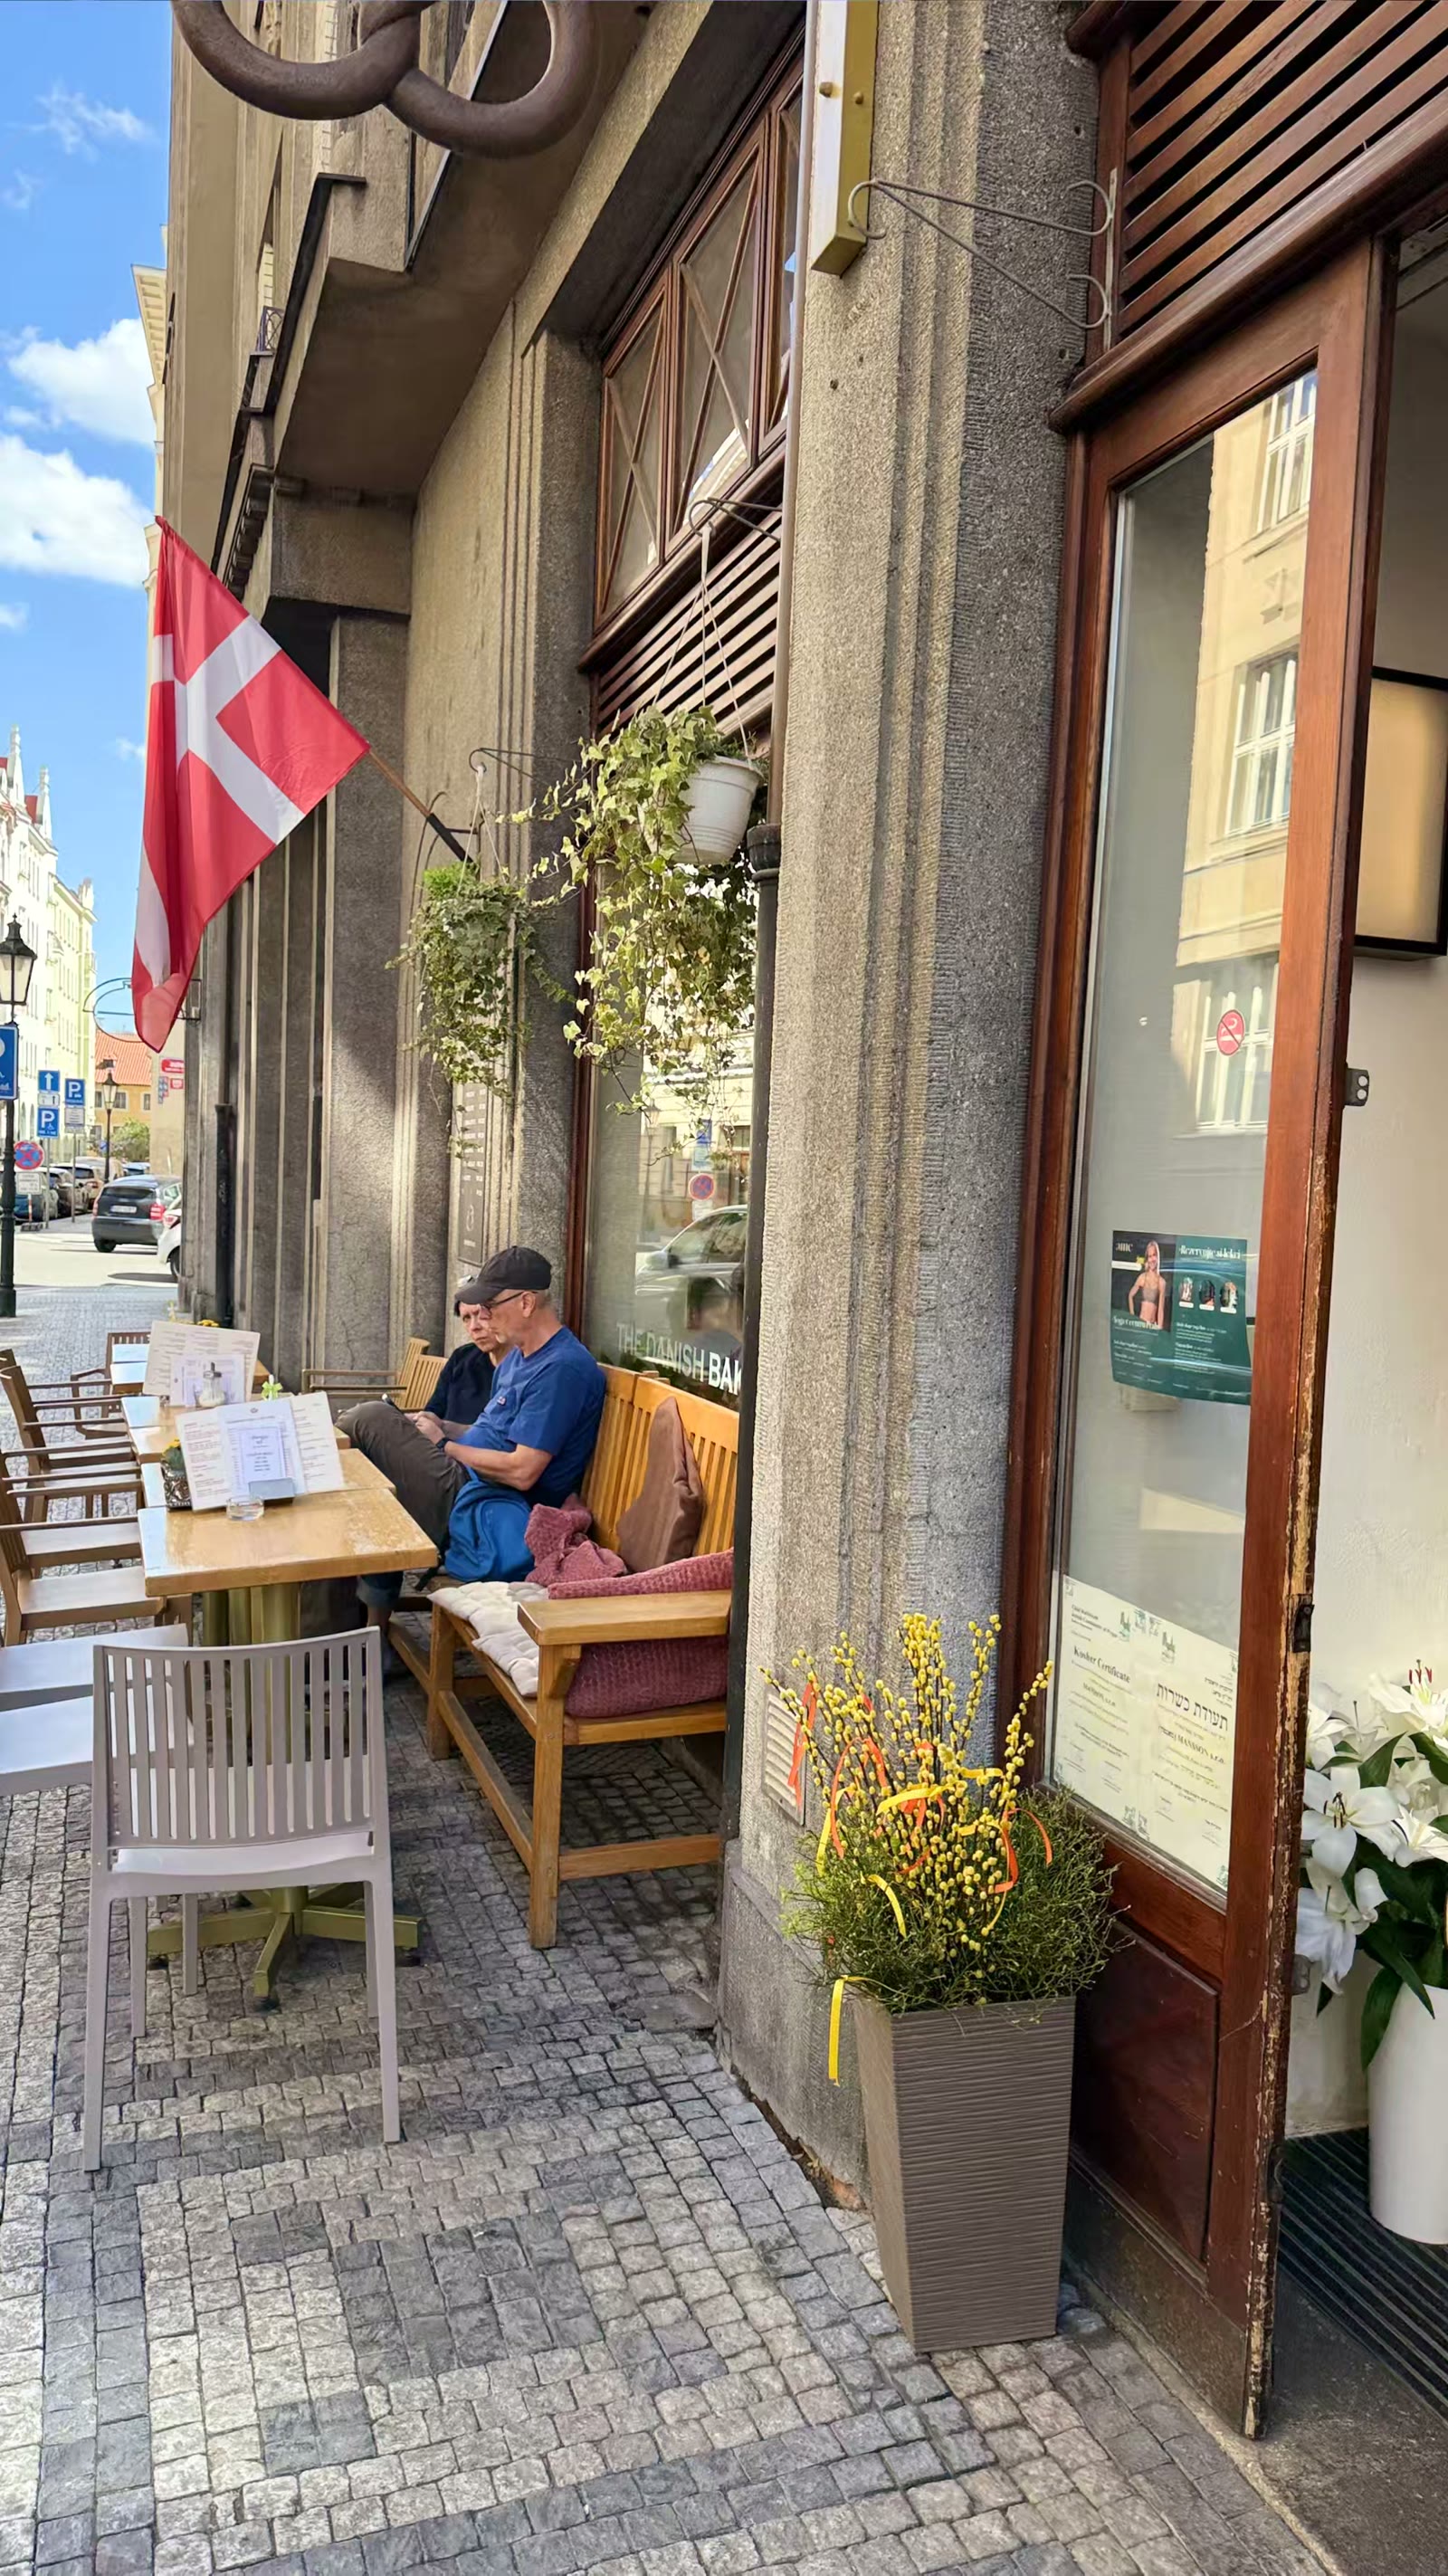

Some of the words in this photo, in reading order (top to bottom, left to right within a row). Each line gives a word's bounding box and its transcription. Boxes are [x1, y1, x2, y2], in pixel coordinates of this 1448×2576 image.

[68, 1081, 81, 1098] P
[41, 1110, 55, 1129] P
[616, 1323, 644, 1358] THE
[646, 1331, 705, 1382] DANISH
[1073, 1645, 1097, 1665] Kosher
[1097, 1657, 1131, 1684] Certificate
[1157, 1683, 1190, 1712] כשרות
[1193, 1702, 1228, 1732] תעודת
